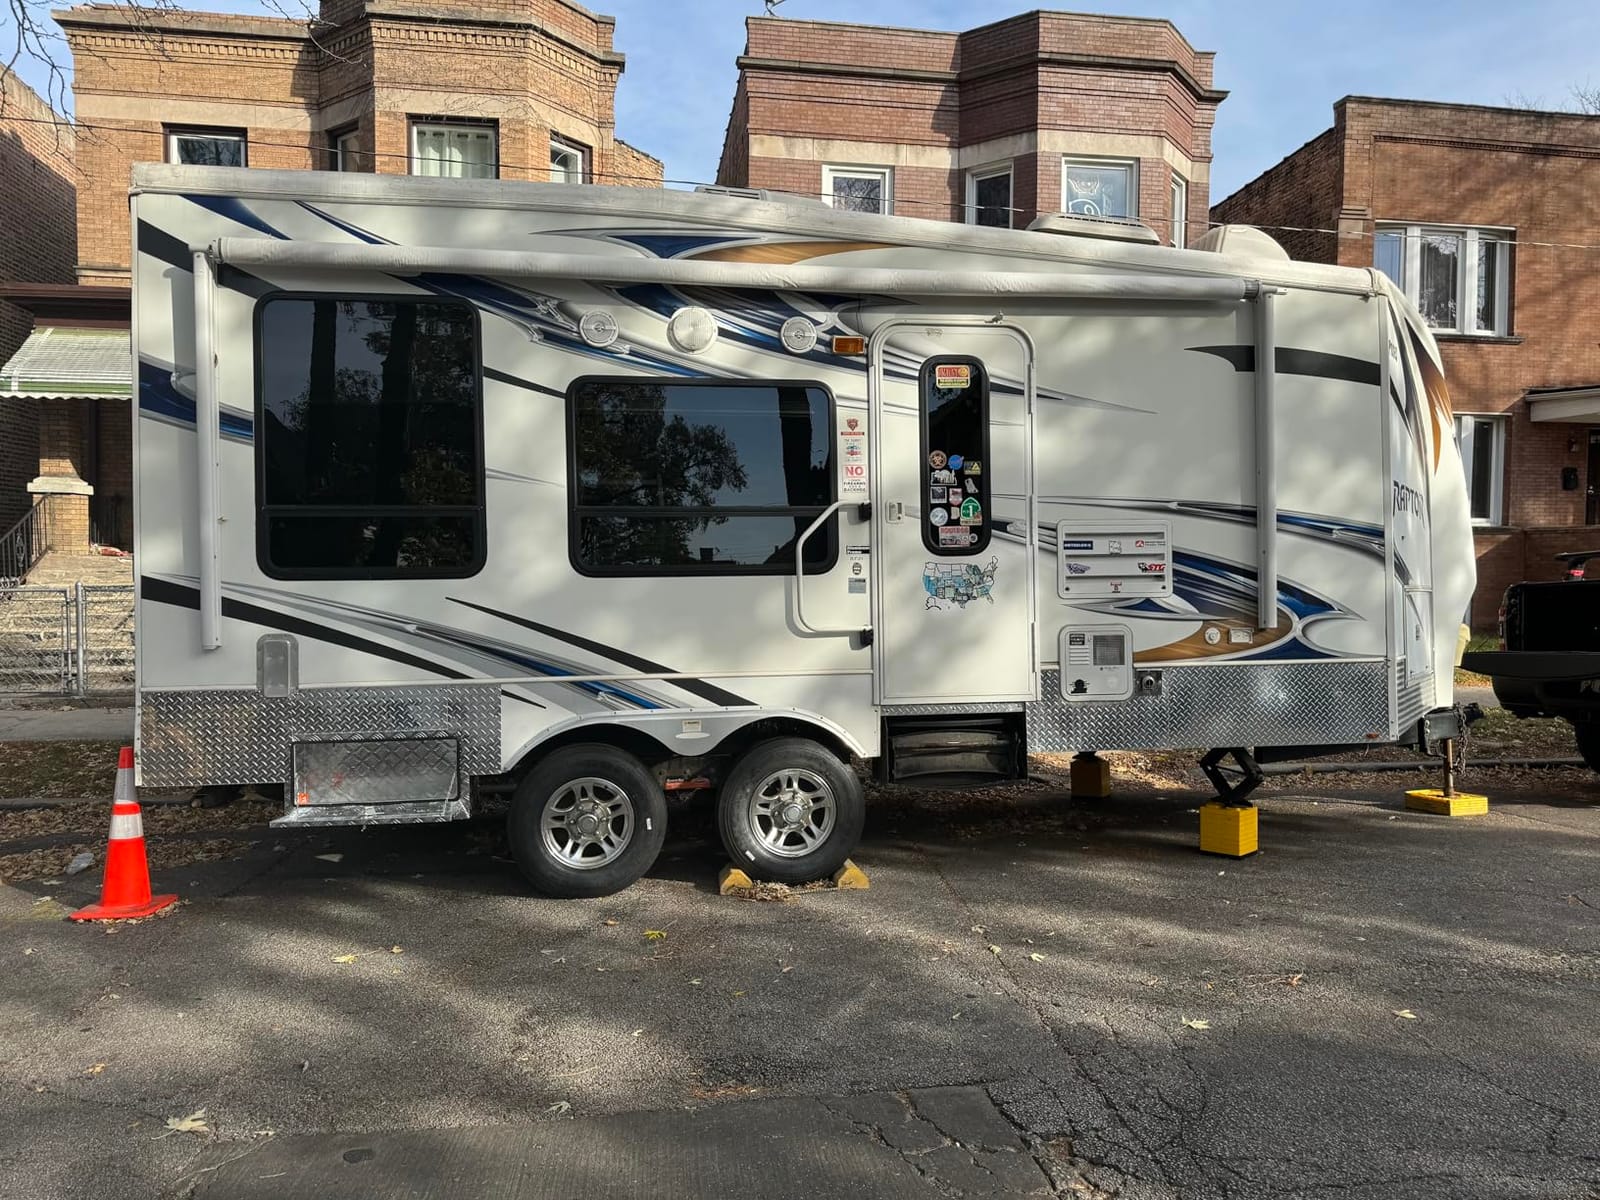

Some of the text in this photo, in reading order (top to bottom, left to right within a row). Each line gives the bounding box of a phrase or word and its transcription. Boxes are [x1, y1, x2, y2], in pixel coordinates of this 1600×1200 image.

[845, 466, 864, 476] NO
[1393, 480, 1425, 528] RAPTOR
[968, 505, 973, 517] 1
